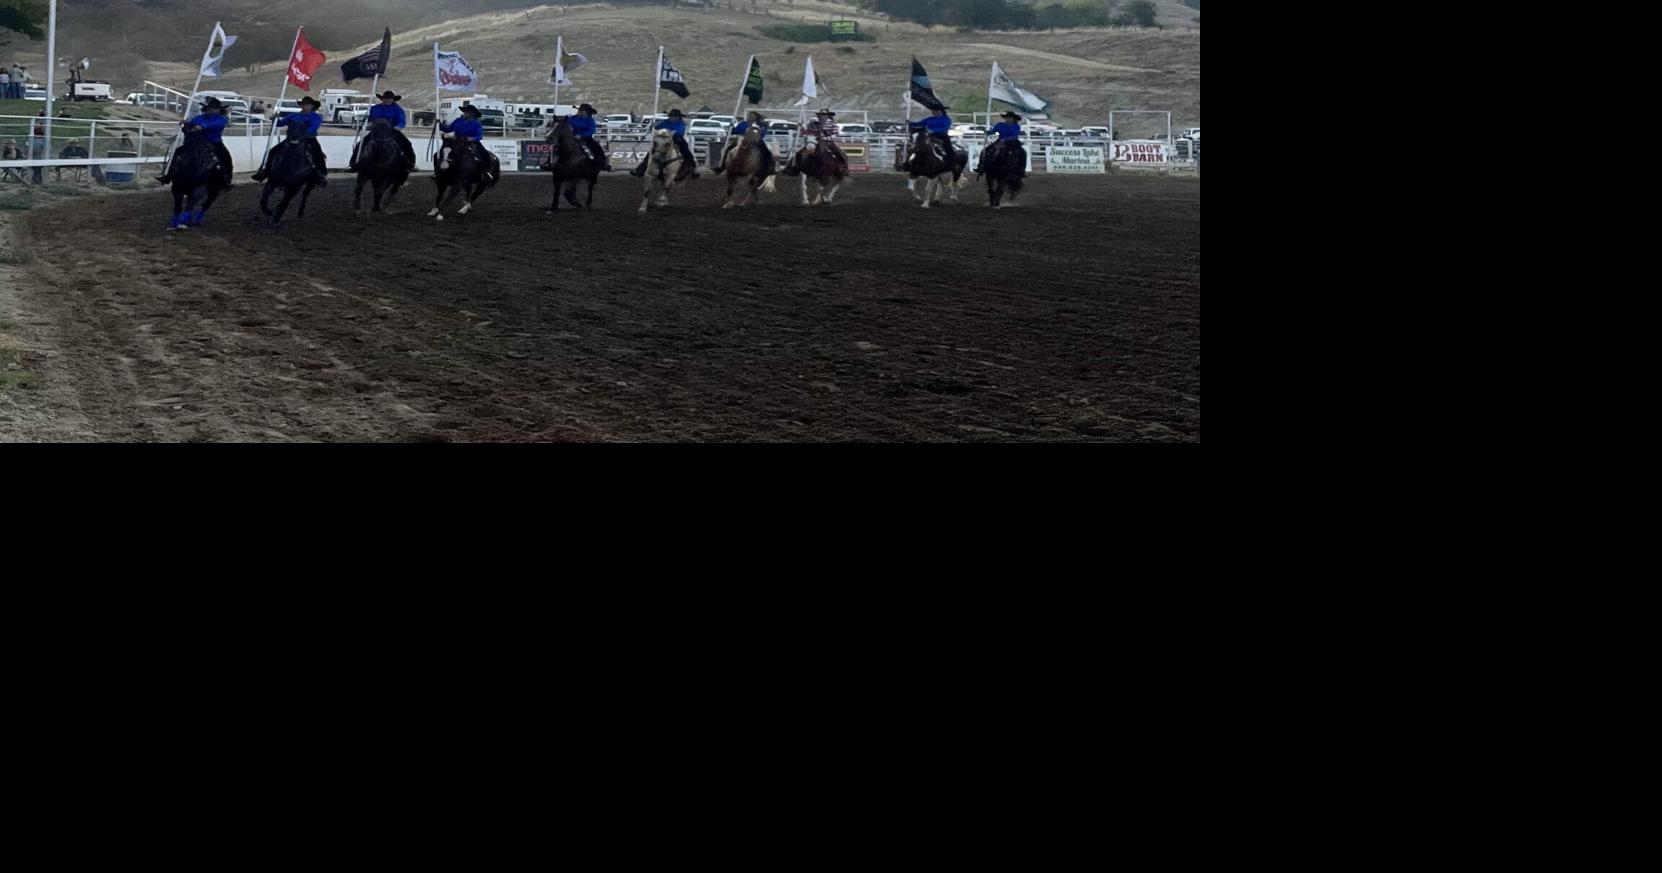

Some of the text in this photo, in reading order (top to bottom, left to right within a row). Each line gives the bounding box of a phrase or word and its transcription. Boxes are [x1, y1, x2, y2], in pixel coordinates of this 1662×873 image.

[1050, 147, 1100, 158] Success Lake
[1131, 144, 1161, 153] BOOT
[1062, 157, 1090, 165] Marina
[1132, 153, 1163, 161] BARN
